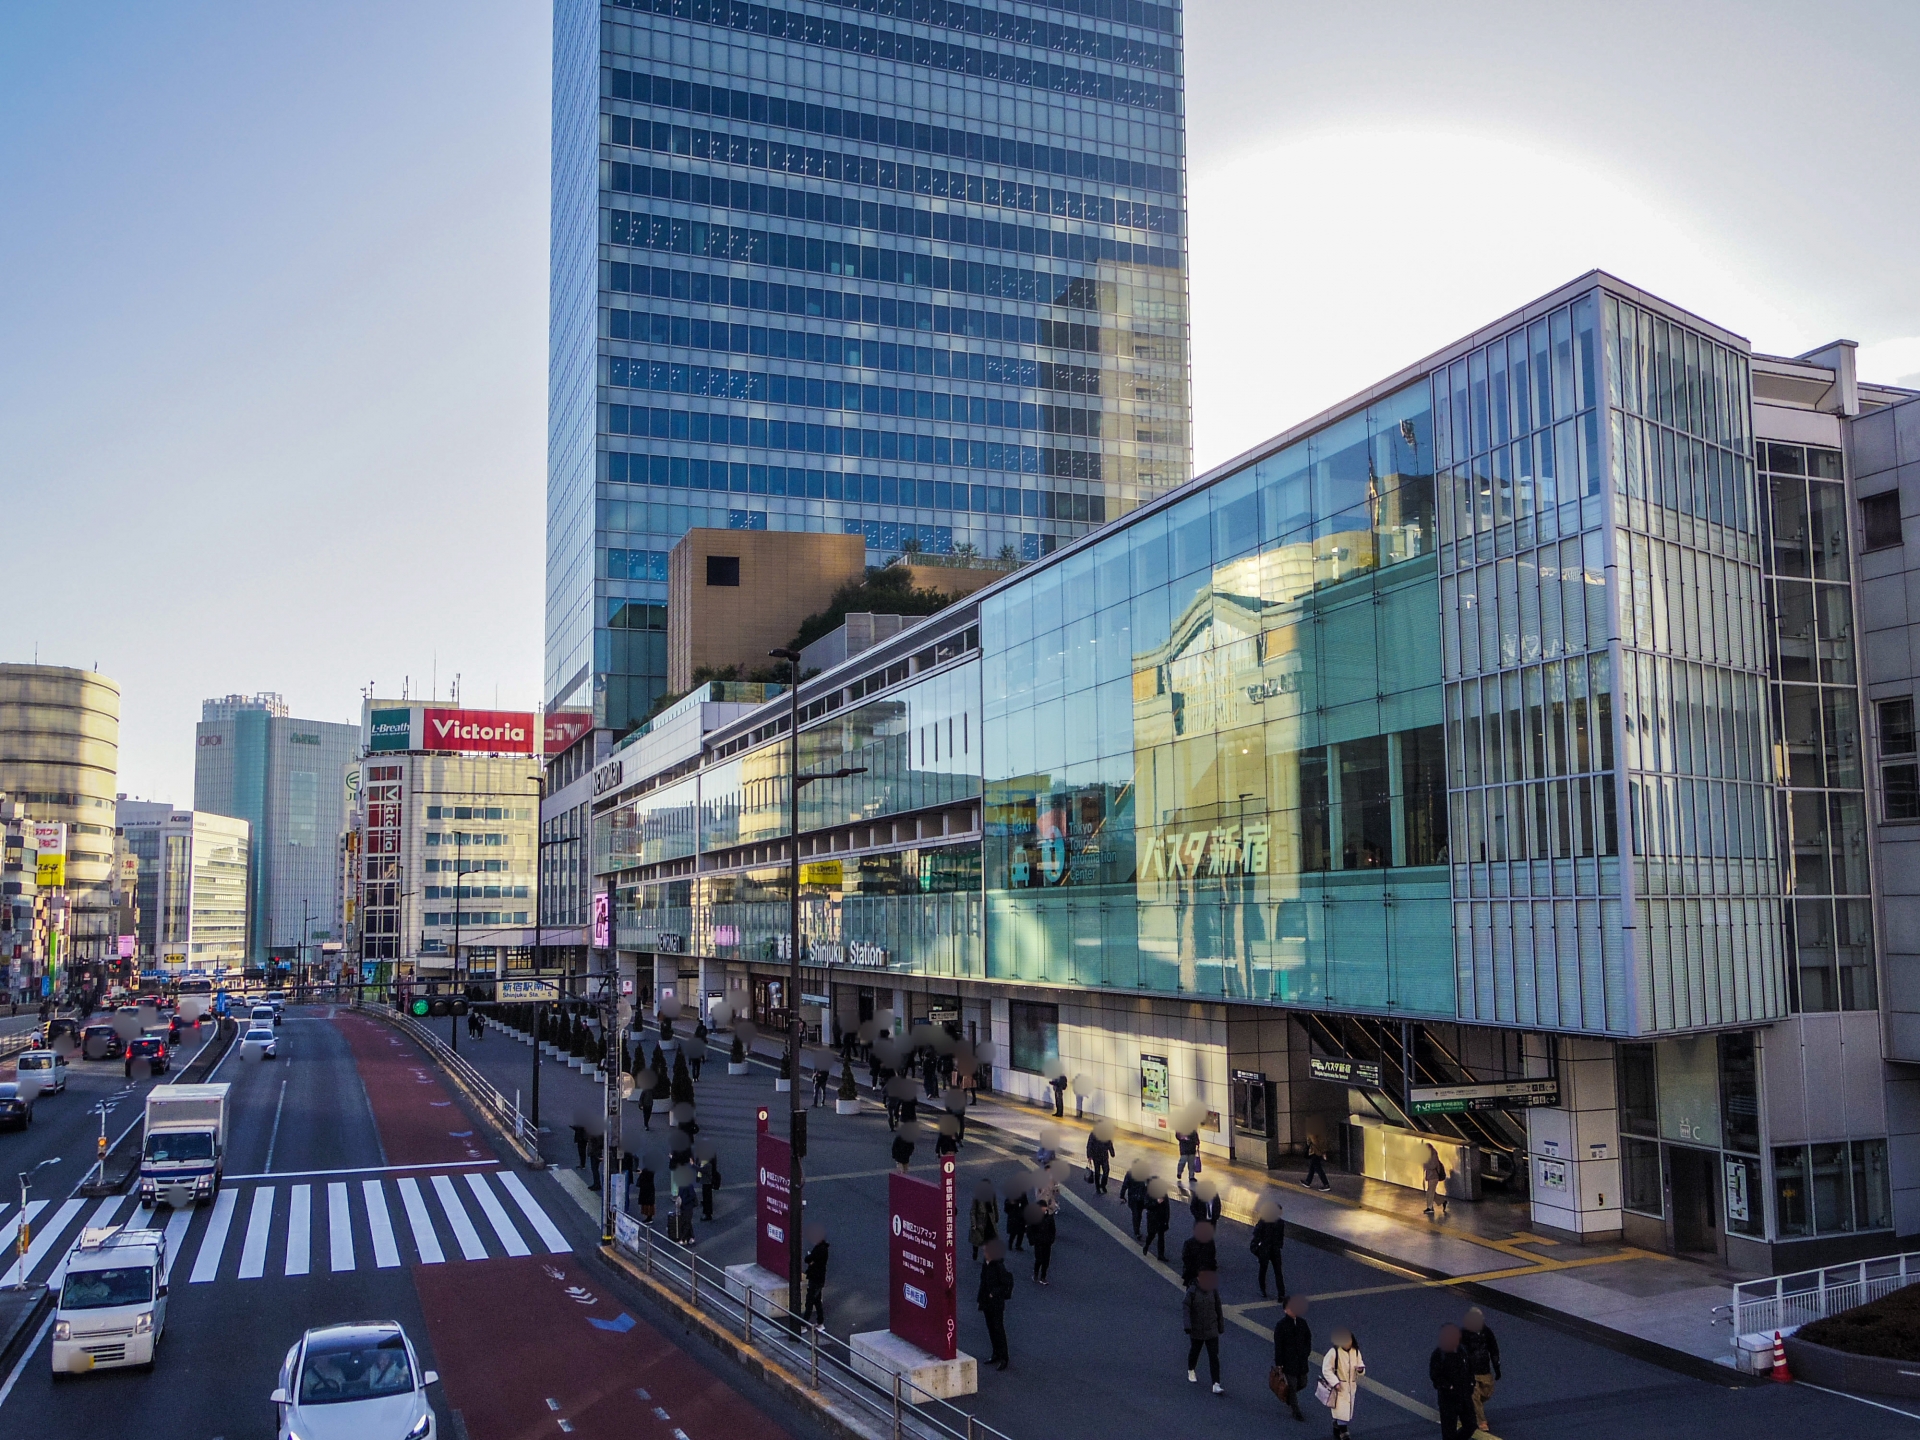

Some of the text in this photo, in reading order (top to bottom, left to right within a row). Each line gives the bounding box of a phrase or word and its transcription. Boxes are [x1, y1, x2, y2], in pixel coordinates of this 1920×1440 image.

[432, 719, 525, 742] Victoria
[385, 785, 398, 851] Victoria
[1069, 822, 1093, 835] Tokyo
[1069, 850, 1117, 865] Information
[1140, 822, 1271, 880] バスタ新宿
[1070, 866, 1096, 880] Center
[809, 940, 883, 968] Shinjuku Station
[503, 981, 554, 992] 新宿駅南口
[1692, 1126, 1702, 1140] C
